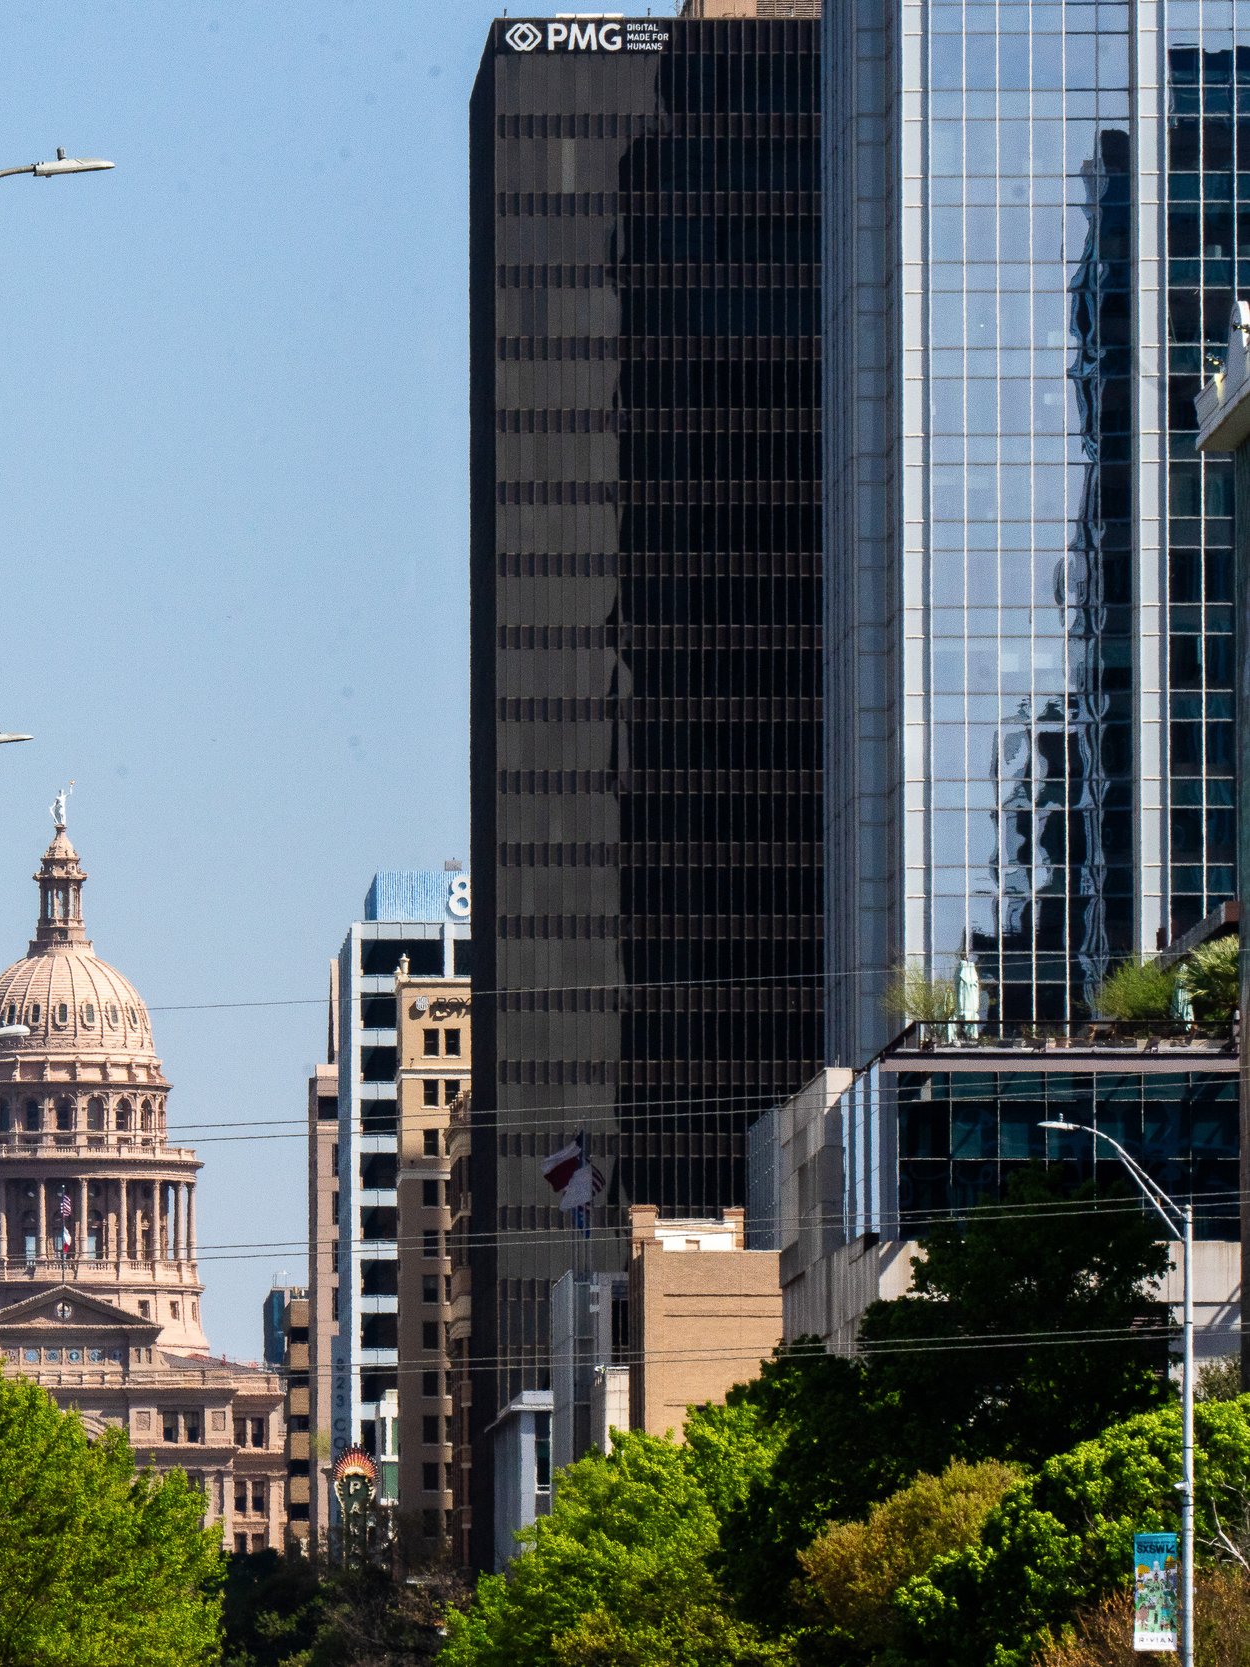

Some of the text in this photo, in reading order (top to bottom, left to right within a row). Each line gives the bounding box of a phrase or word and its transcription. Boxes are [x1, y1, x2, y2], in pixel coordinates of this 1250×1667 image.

[626, 23, 659, 31] DIGITAL
[547, 23, 622, 51] PMG
[626, 33, 669, 41] MADE FOR
[626, 42, 663, 50] HUMANS
[1136, 1544, 1165, 1554] SXSW
